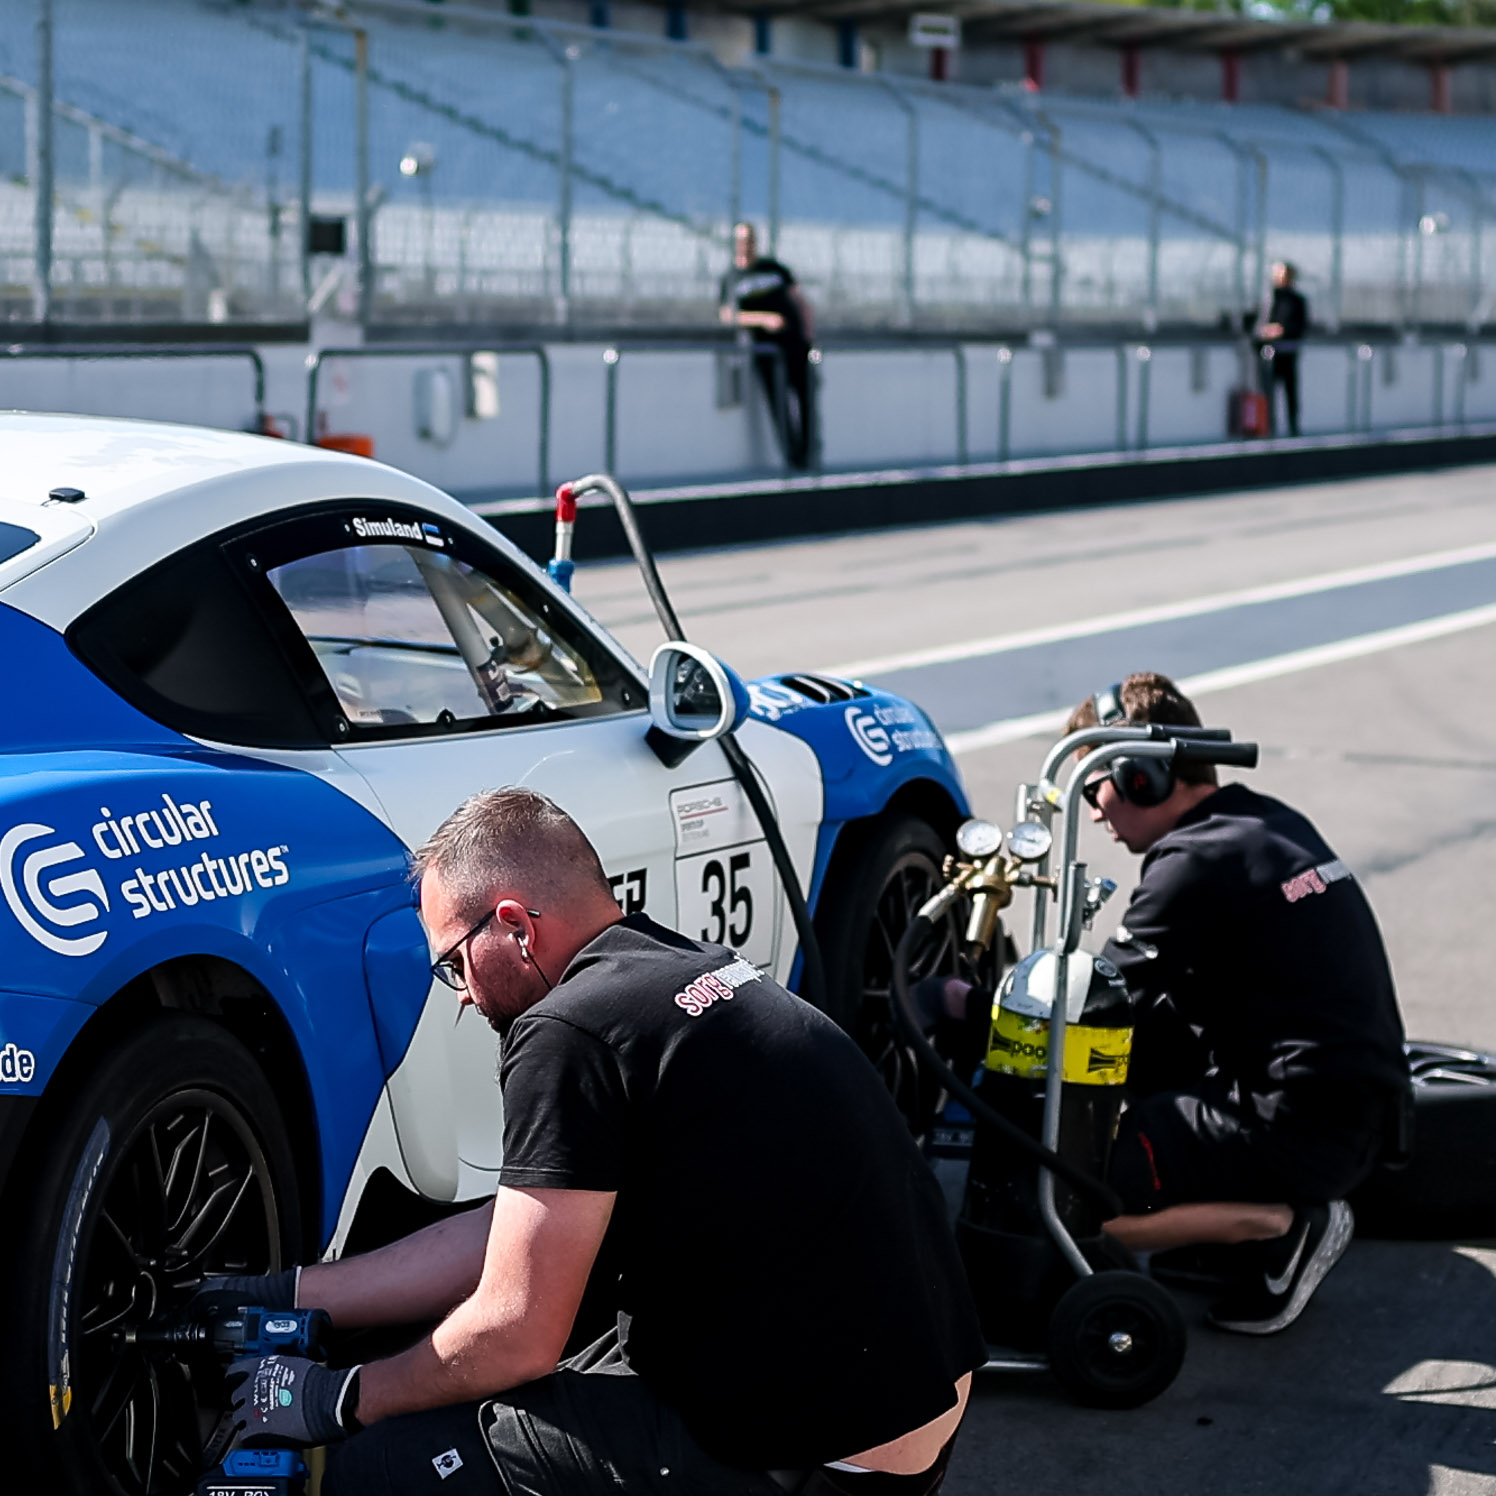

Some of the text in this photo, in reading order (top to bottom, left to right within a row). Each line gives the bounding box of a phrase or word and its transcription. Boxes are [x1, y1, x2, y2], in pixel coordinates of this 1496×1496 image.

[352, 517, 423, 541] Simuland
[91, 793, 219, 860] circular
[120, 846, 290, 919] structures
[701, 851, 753, 948] 35
